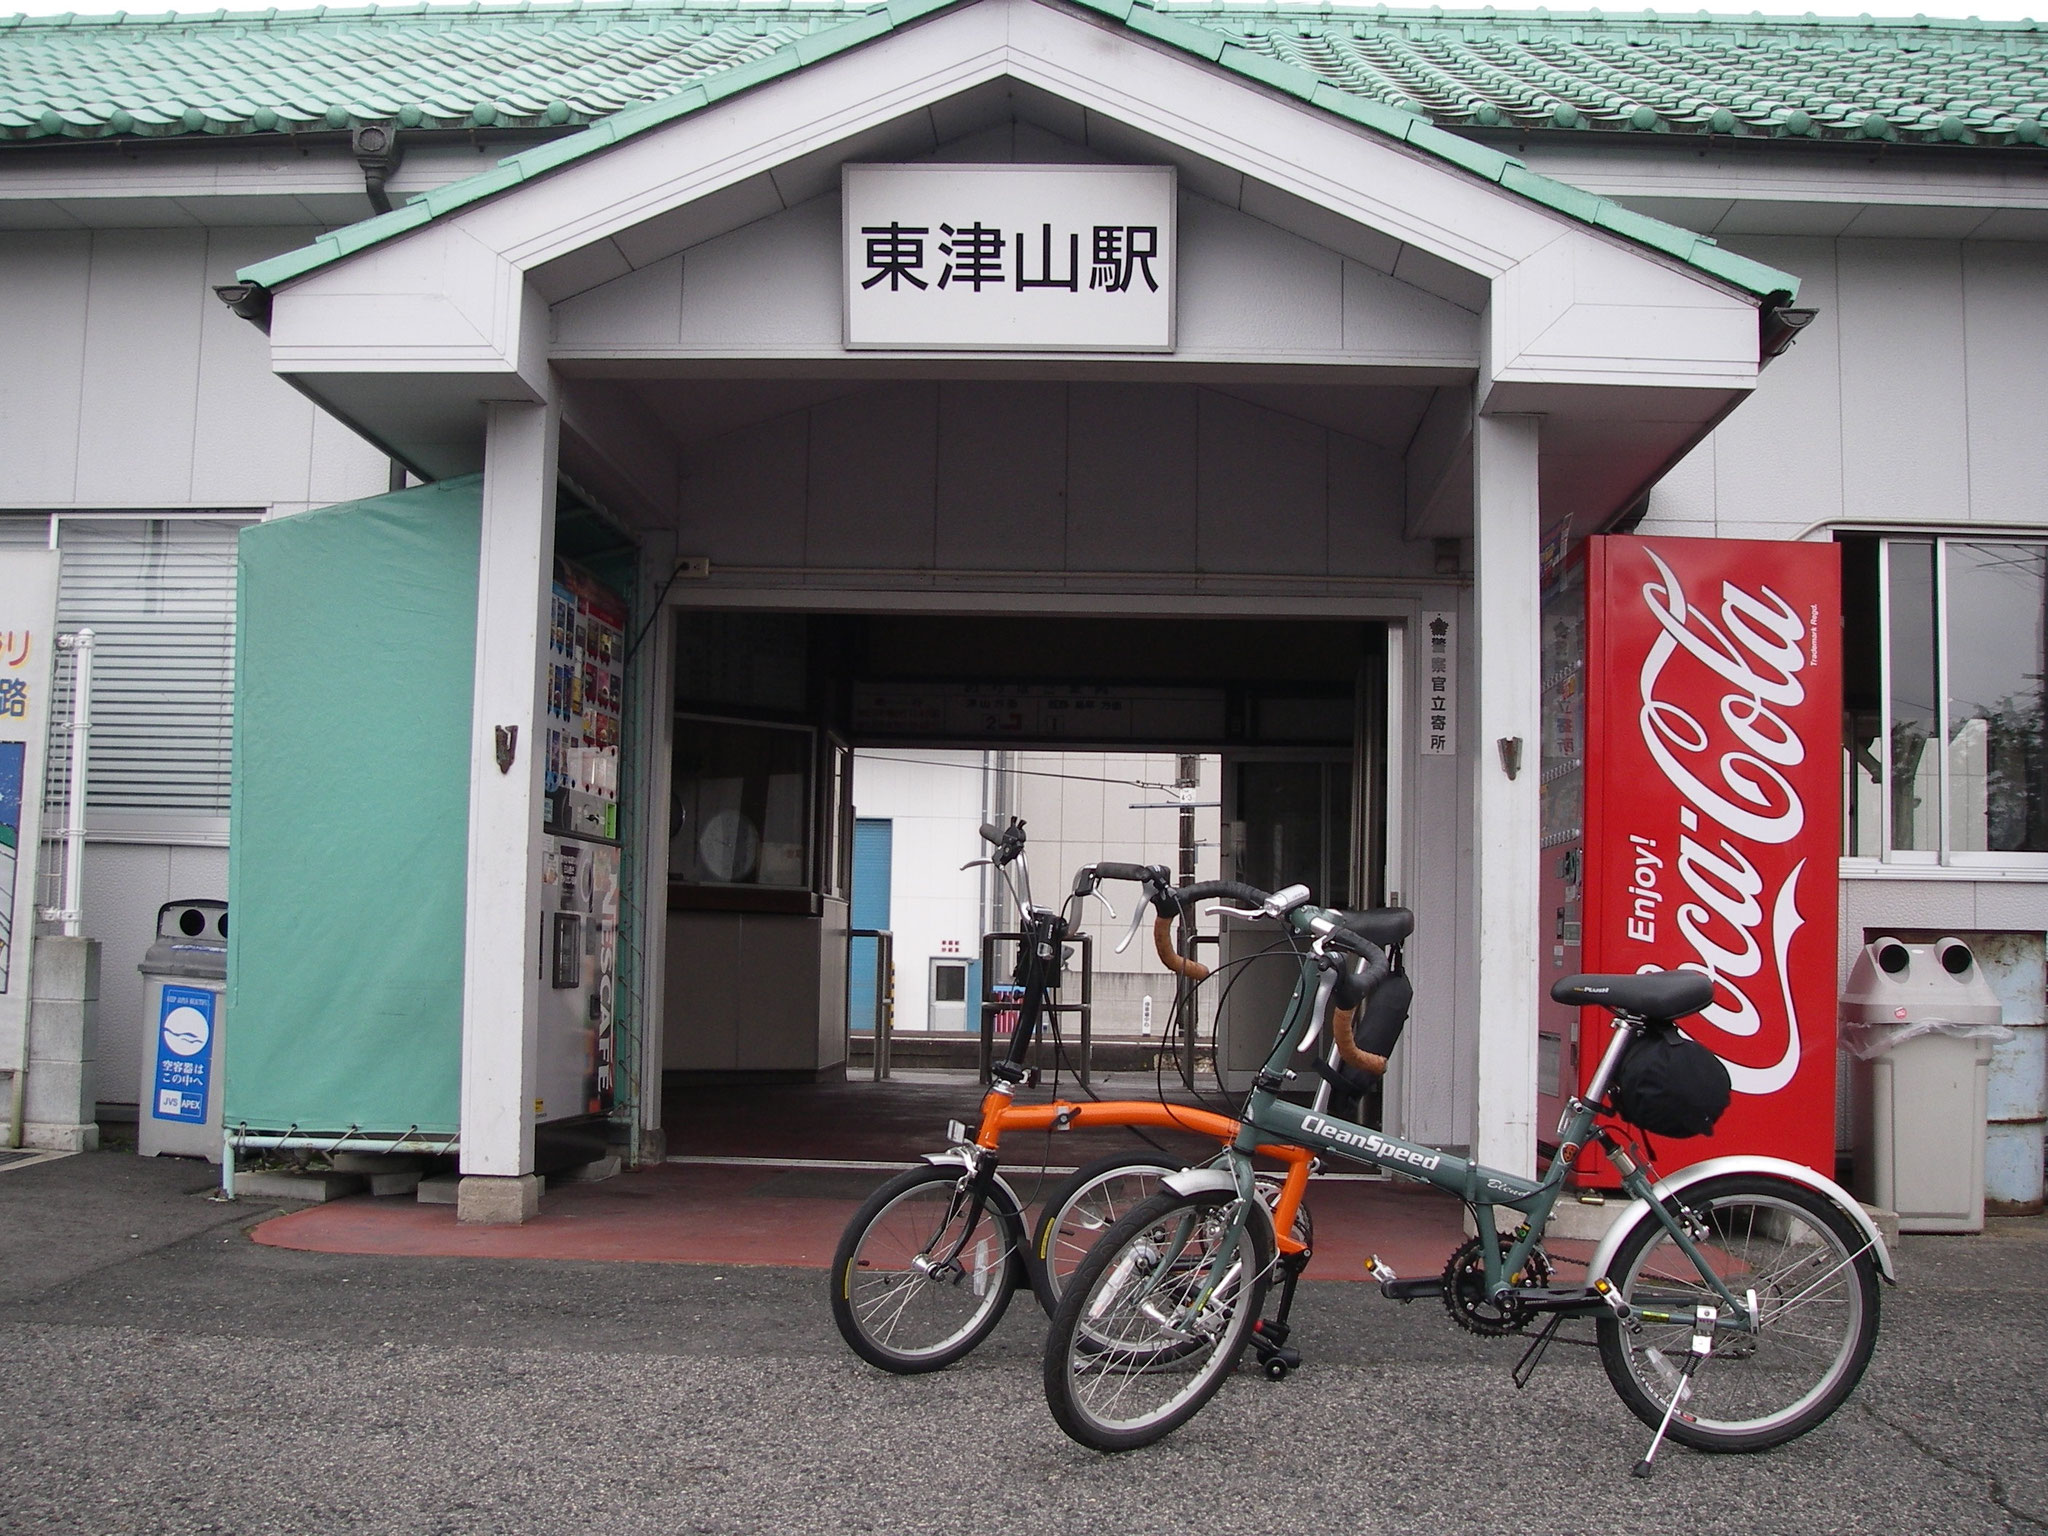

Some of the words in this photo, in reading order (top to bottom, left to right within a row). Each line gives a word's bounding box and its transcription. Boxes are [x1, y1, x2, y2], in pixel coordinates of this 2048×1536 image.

[860, 221, 1159, 293] 東津山駅
[1810, 603, 1819, 626] Regd.
[1810, 627, 1818, 667] Trademark
[1430, 637, 1447, 751] 警察官立寄所
[1627, 834, 1663, 943] Enjoy!
[162, 1059, 204, 1075] 空容器は
[162, 1073, 204, 1087] この中へ
[163, 1097, 178, 1107] JVS
[181, 1099, 200, 1110] APEX
[1300, 1115, 1440, 1171] CleanSpeed
